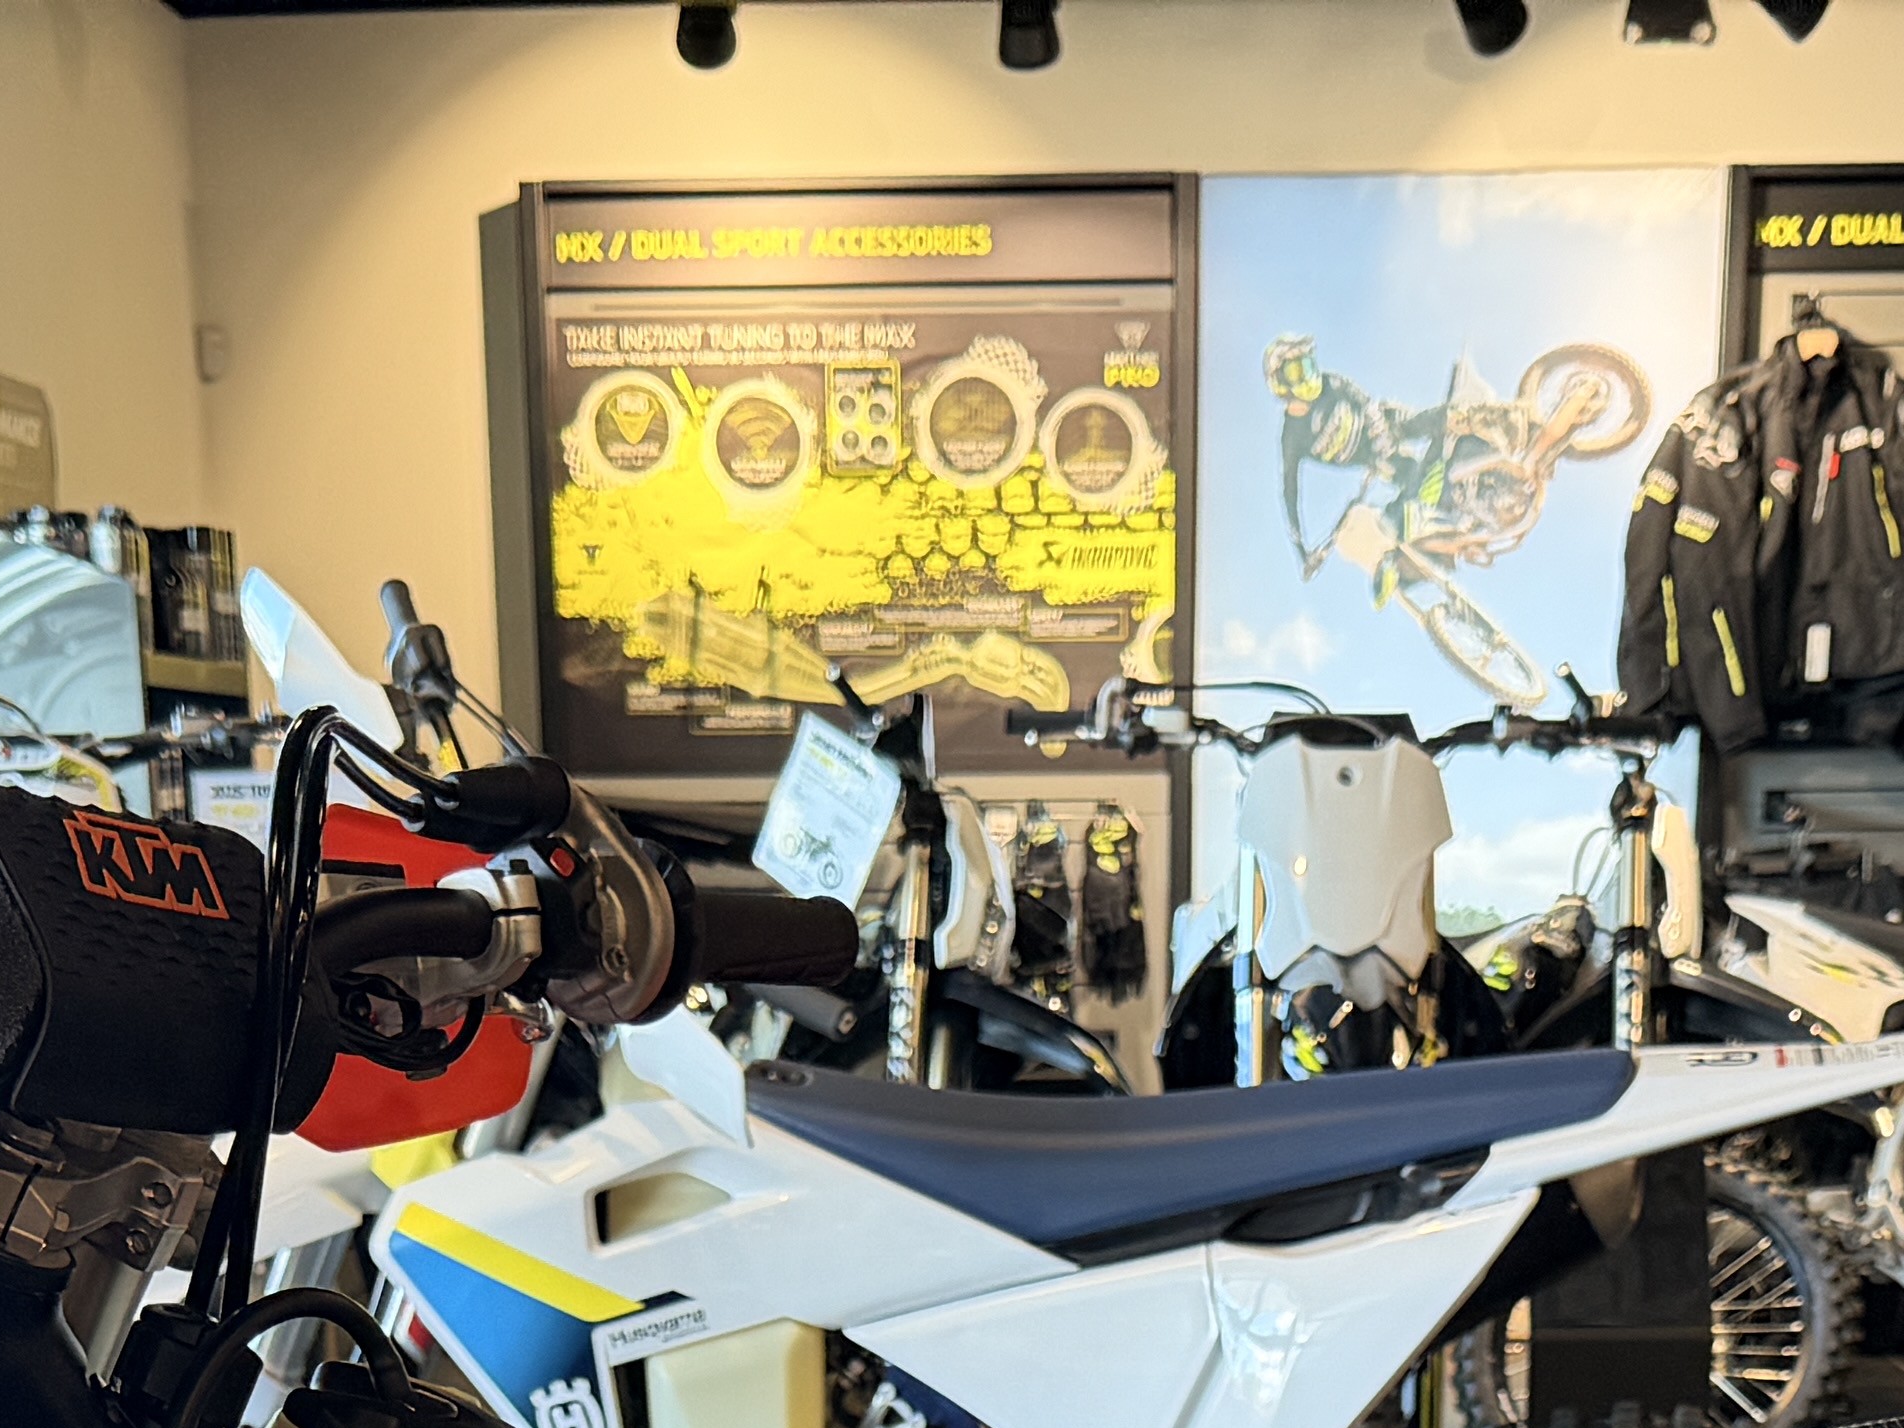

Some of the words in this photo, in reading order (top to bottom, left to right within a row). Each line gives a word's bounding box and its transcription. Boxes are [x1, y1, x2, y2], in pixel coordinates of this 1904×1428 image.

[632, 229, 708, 261] DUAL
[712, 226, 804, 258] SPORT
[809, 224, 993, 258] ACCESSORIES
[787, 324, 817, 349] TO
[63, 810, 230, 920] KTM
